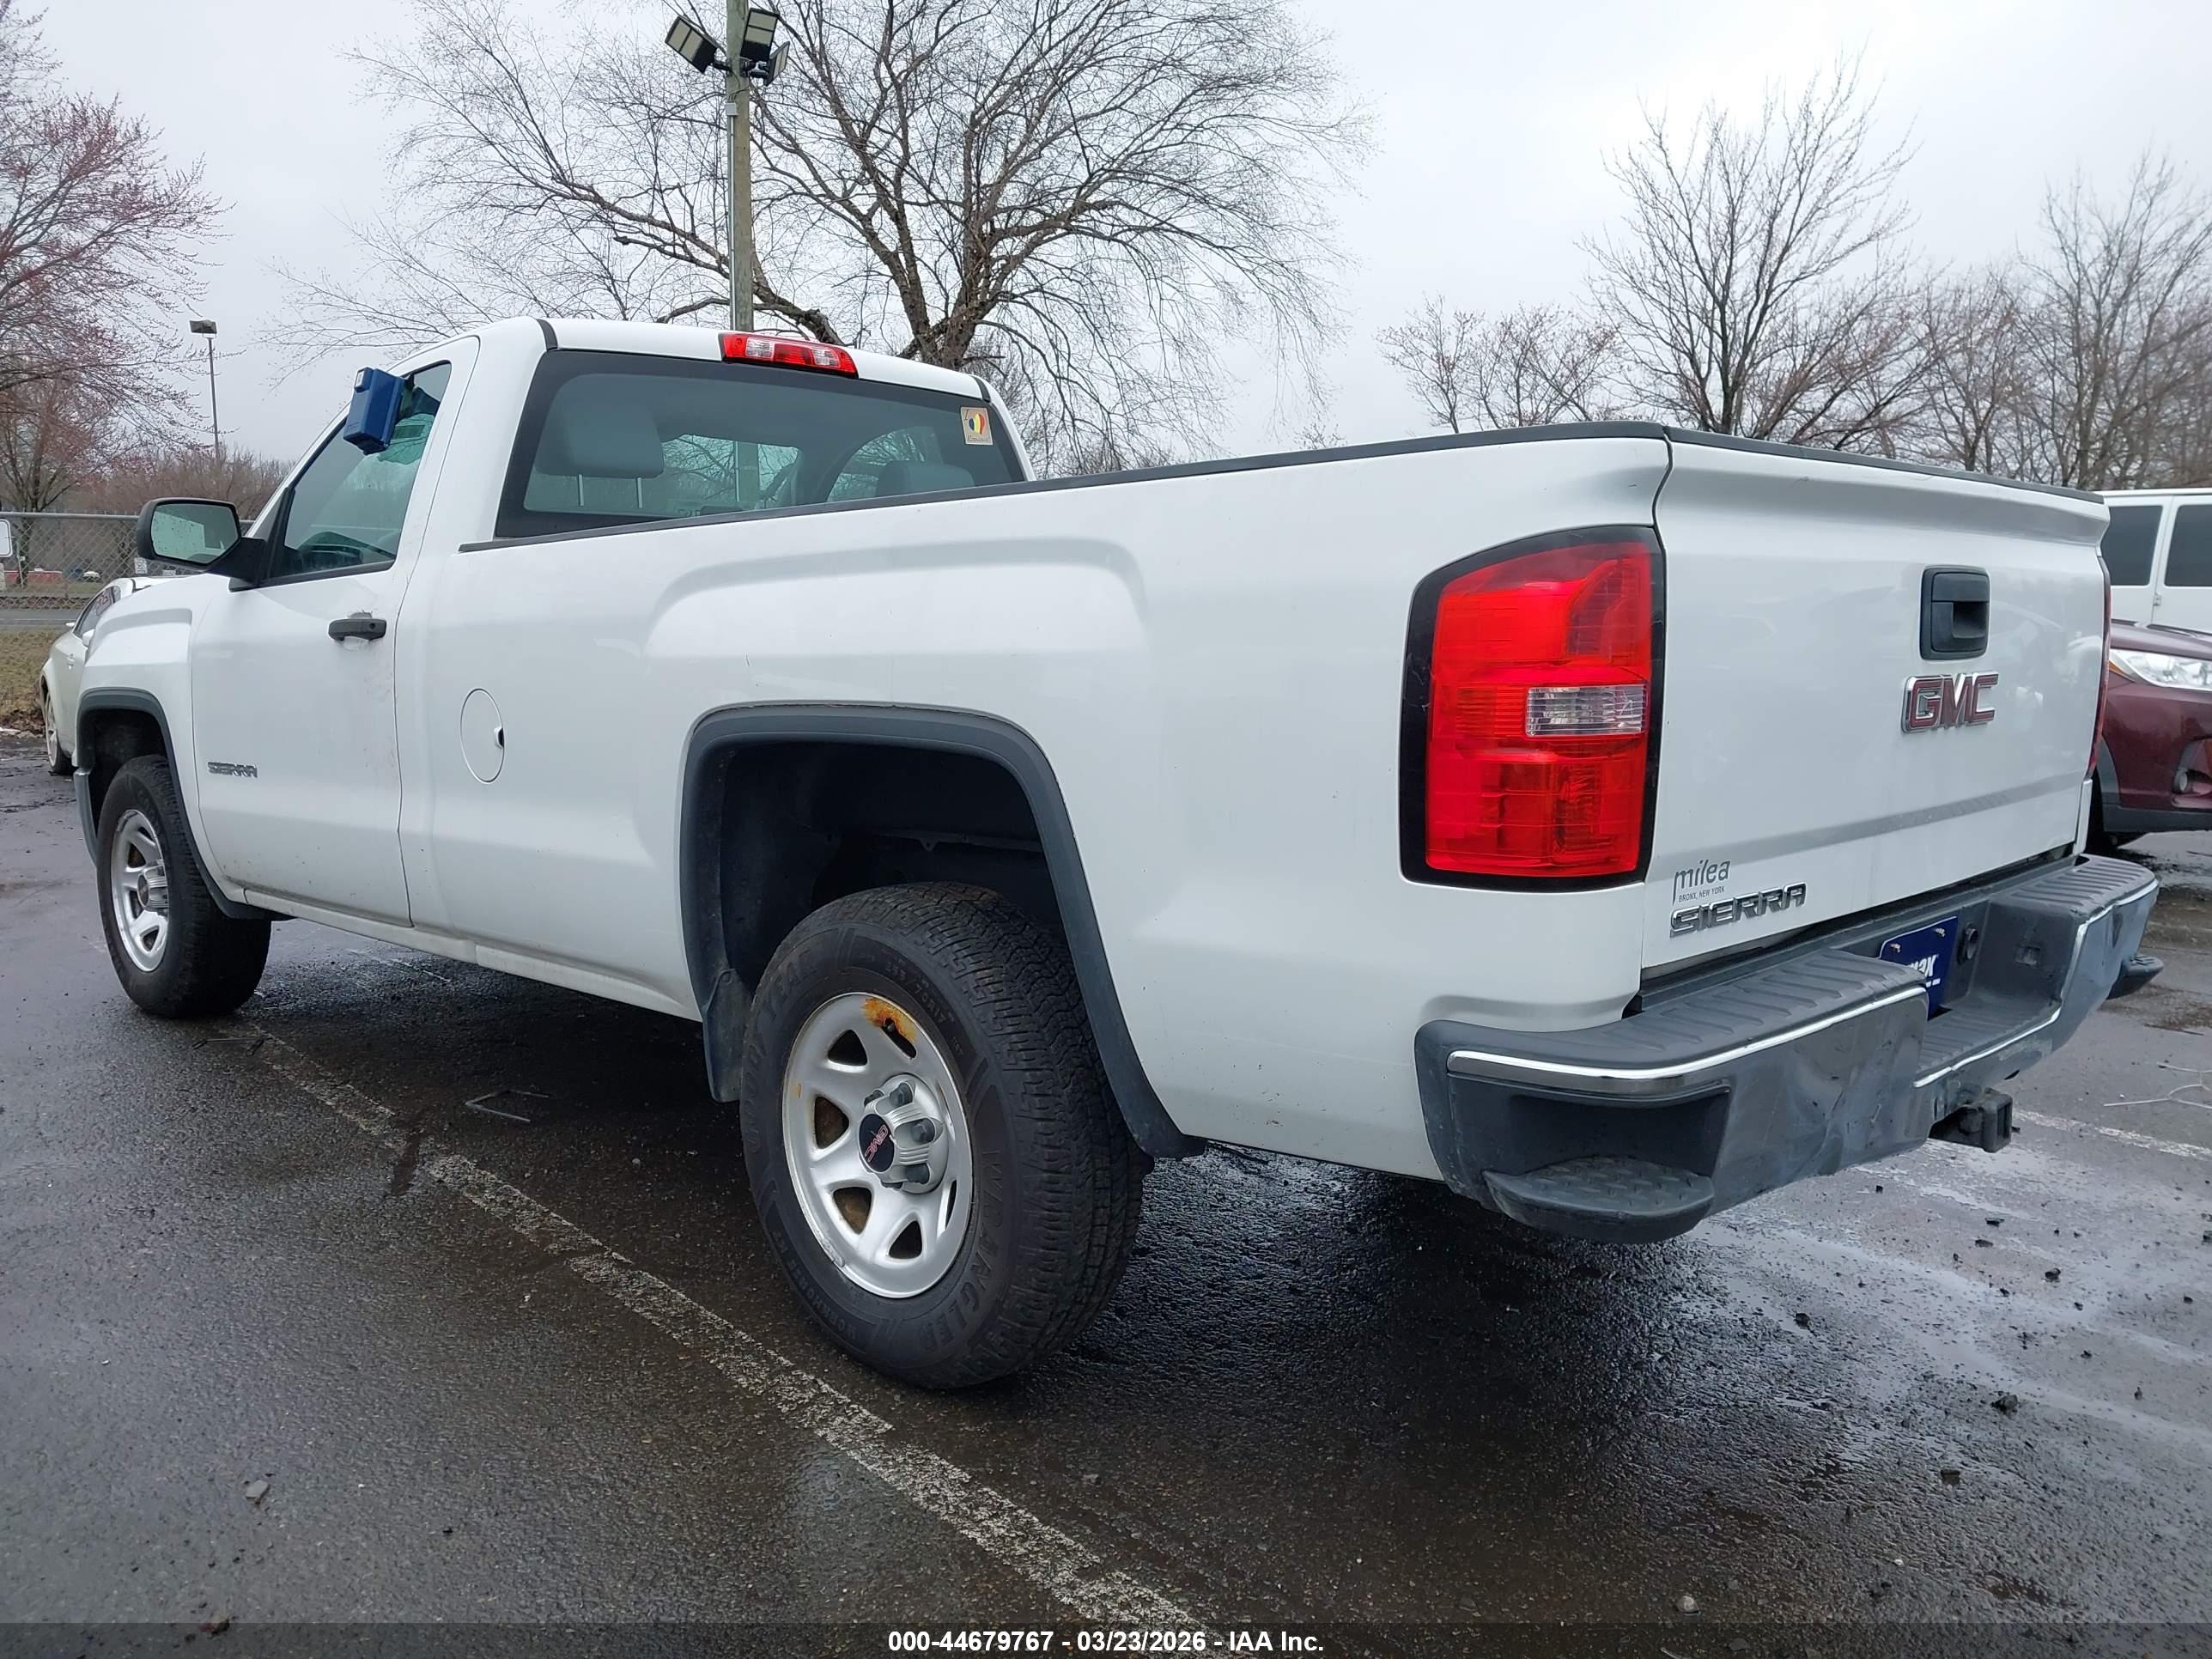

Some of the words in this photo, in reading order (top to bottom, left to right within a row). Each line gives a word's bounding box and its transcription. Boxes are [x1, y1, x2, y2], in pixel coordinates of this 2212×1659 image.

[1901, 671, 1999, 733] GMC
[207, 762, 258, 778] SIERRA
[1672, 860, 1731, 906] milea
[1698, 889, 1711, 899] NEW
[1711, 885, 1726, 896] YORK
[1669, 881, 1808, 938] SIERRA
[864, 1124, 889, 1163] GMC
